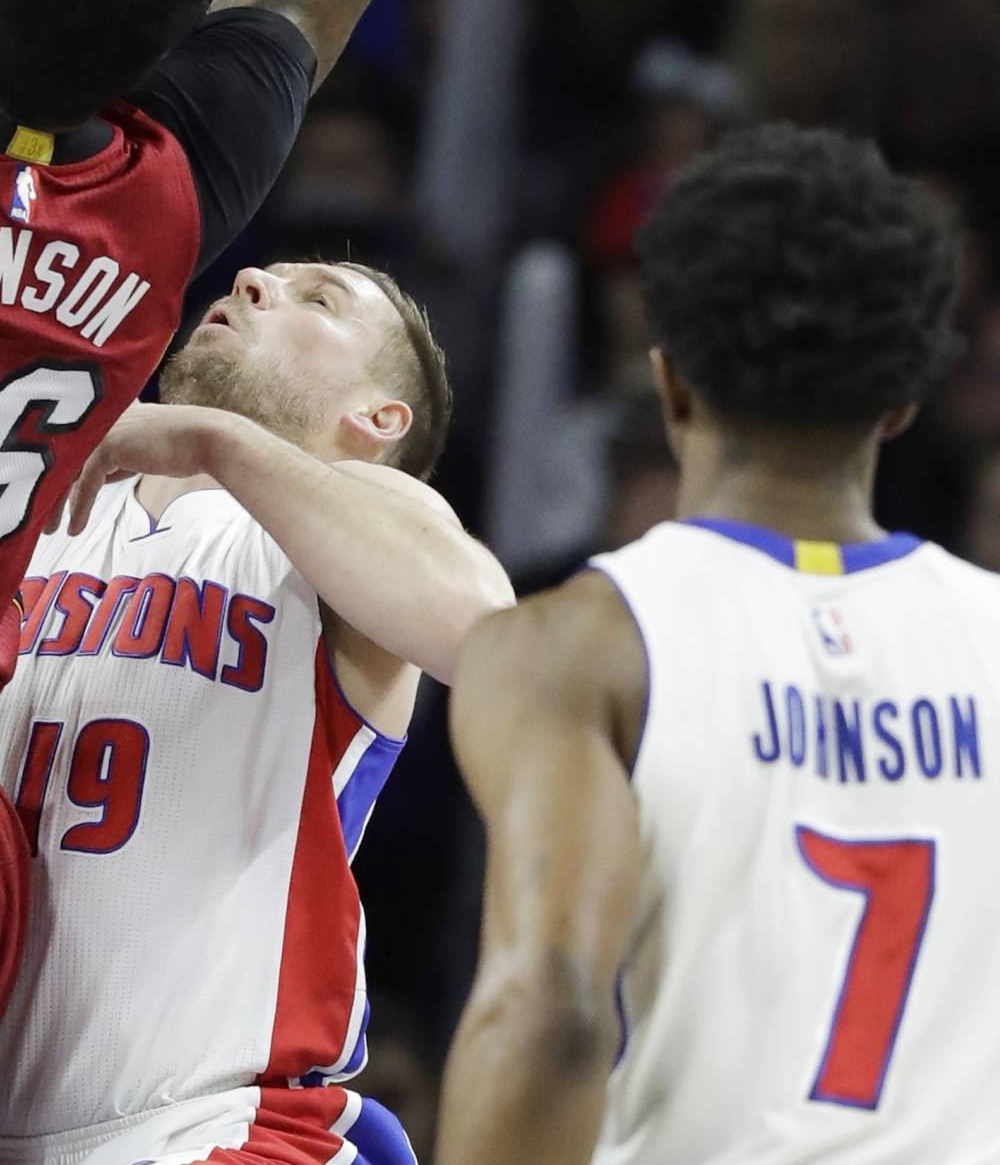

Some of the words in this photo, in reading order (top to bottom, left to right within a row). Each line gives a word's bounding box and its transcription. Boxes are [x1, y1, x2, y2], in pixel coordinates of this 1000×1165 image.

[15, 718, 151, 858] 19
[753, 680, 982, 784] JOHNSON
[794, 823, 937, 1112] 7
